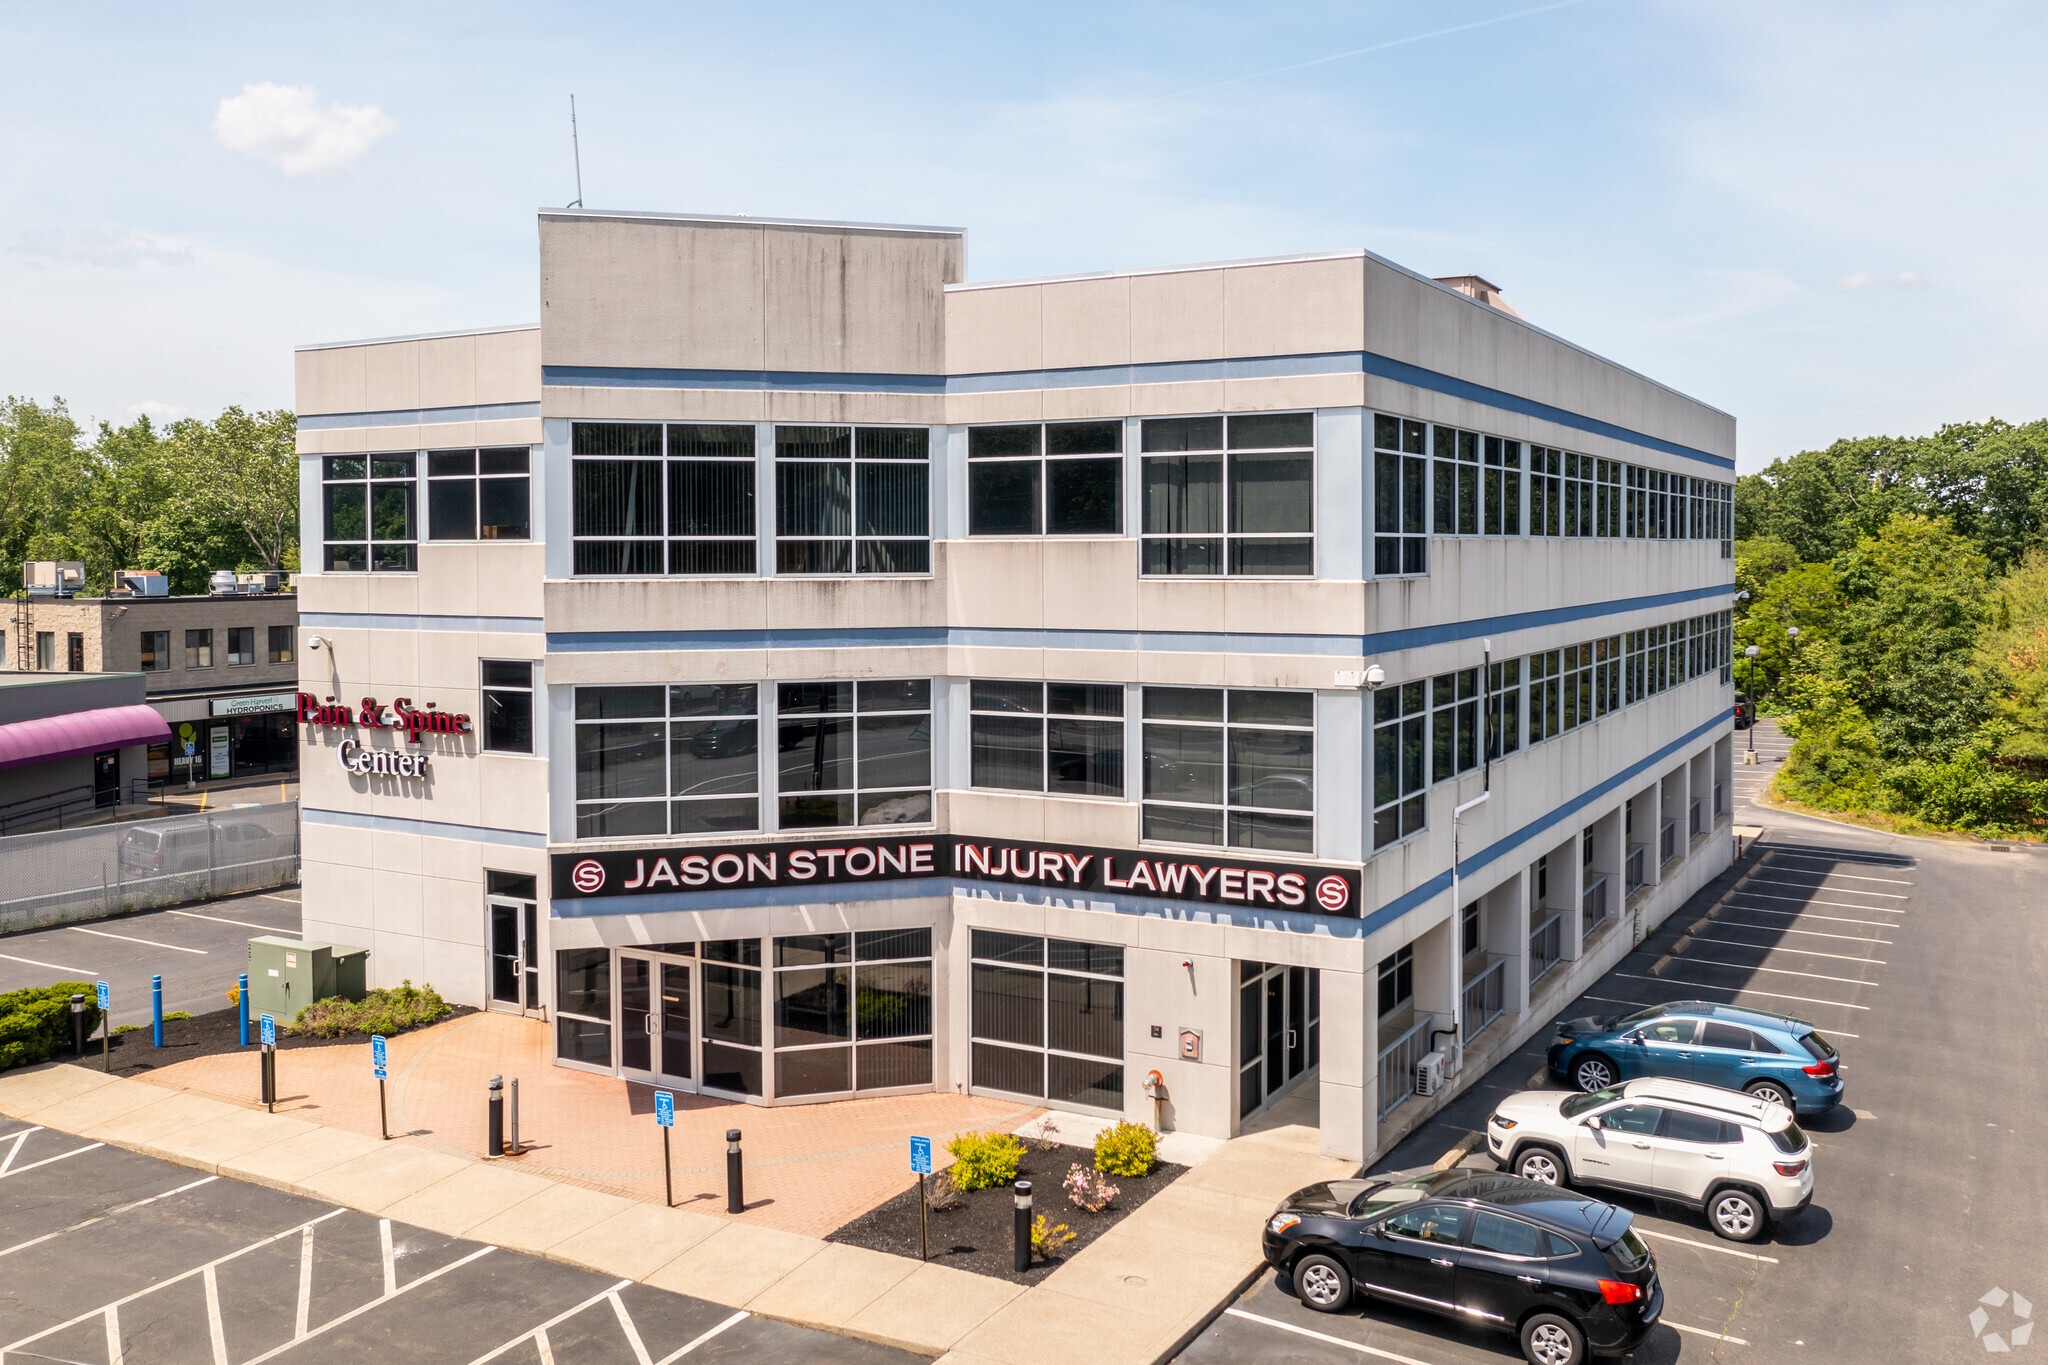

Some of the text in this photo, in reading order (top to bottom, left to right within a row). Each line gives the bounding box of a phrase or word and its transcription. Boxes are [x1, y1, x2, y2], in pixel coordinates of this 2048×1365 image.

[226, 703, 284, 715] HYDROPONICS
[231, 699, 250, 707] Green
[297, 692, 470, 744] Pain & Spine
[194, 755, 202, 764] 16
[336, 738, 427, 777] Center
[624, 851, 777, 889] JASON
[787, 843, 935, 881] STONE
[953, 843, 1094, 884] INJURY
[1103, 856, 1307, 905] LAWYERS
